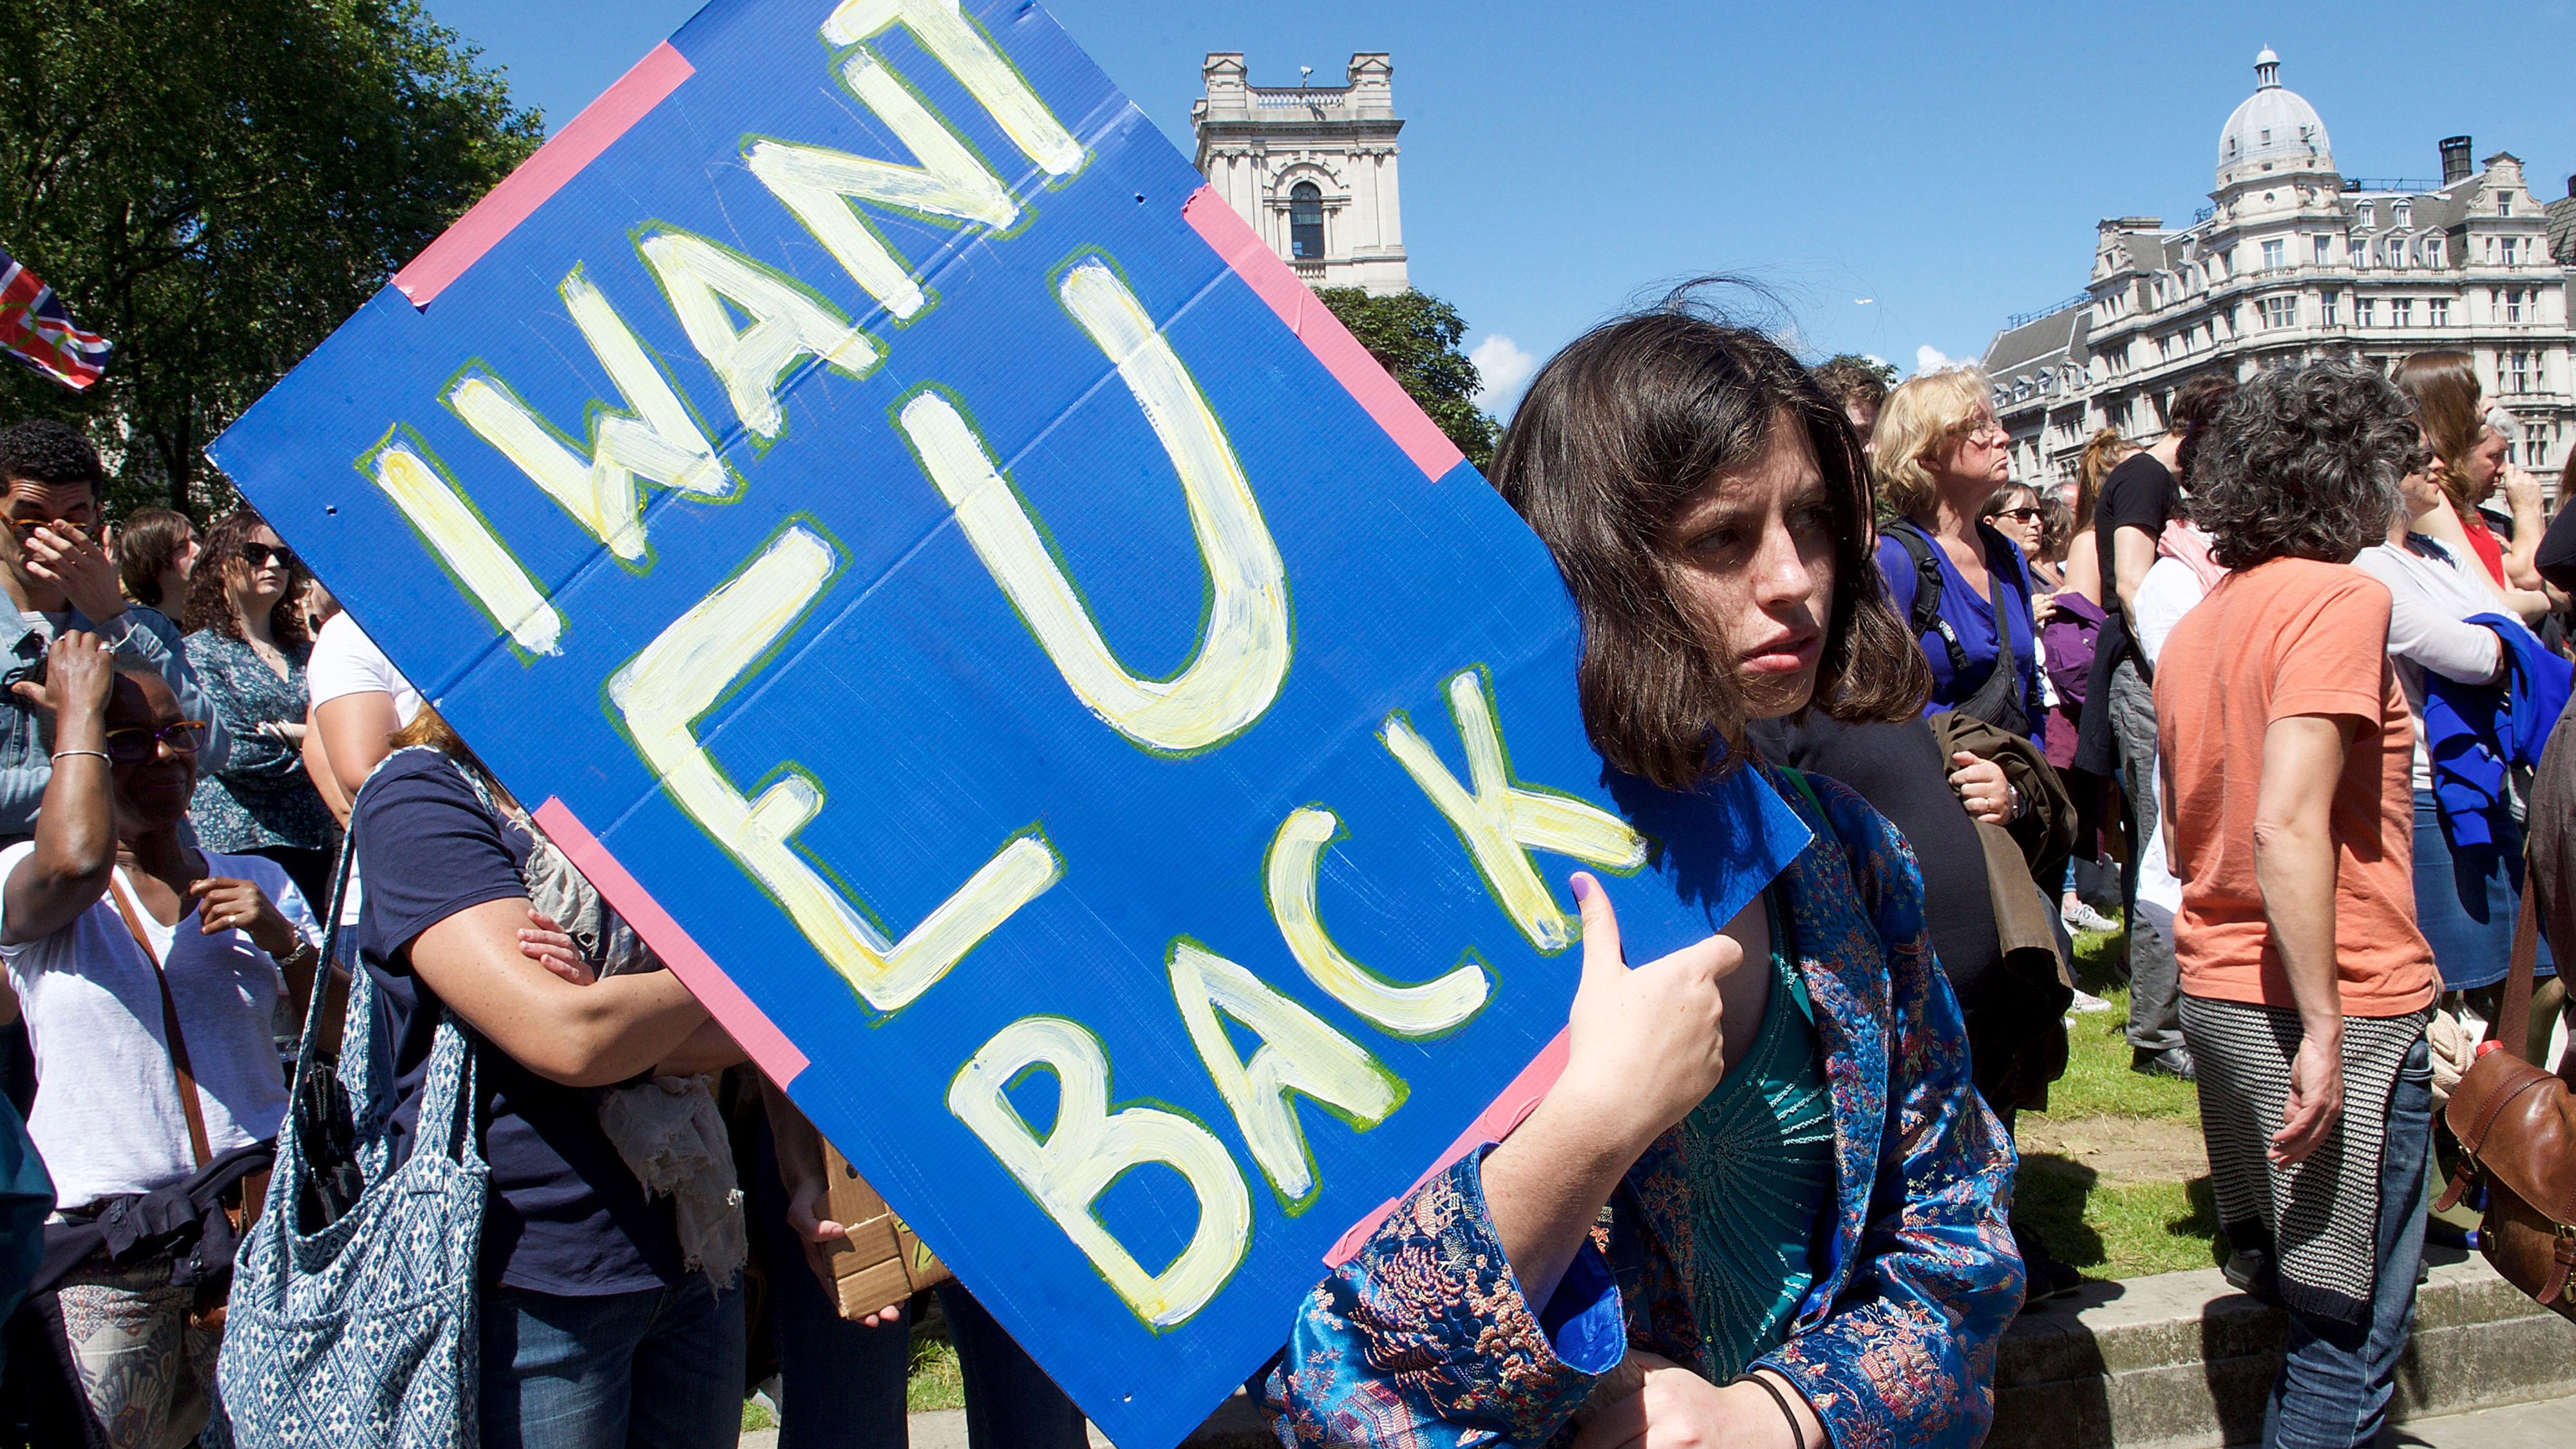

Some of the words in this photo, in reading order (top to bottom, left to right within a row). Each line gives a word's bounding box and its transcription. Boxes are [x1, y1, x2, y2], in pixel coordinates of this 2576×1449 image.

[361, 428, 564, 659] I
[440, 0, 1091, 568] WANT
[604, 249, 1292, 1019] EU
[947, 666, 1653, 1331] BACK
